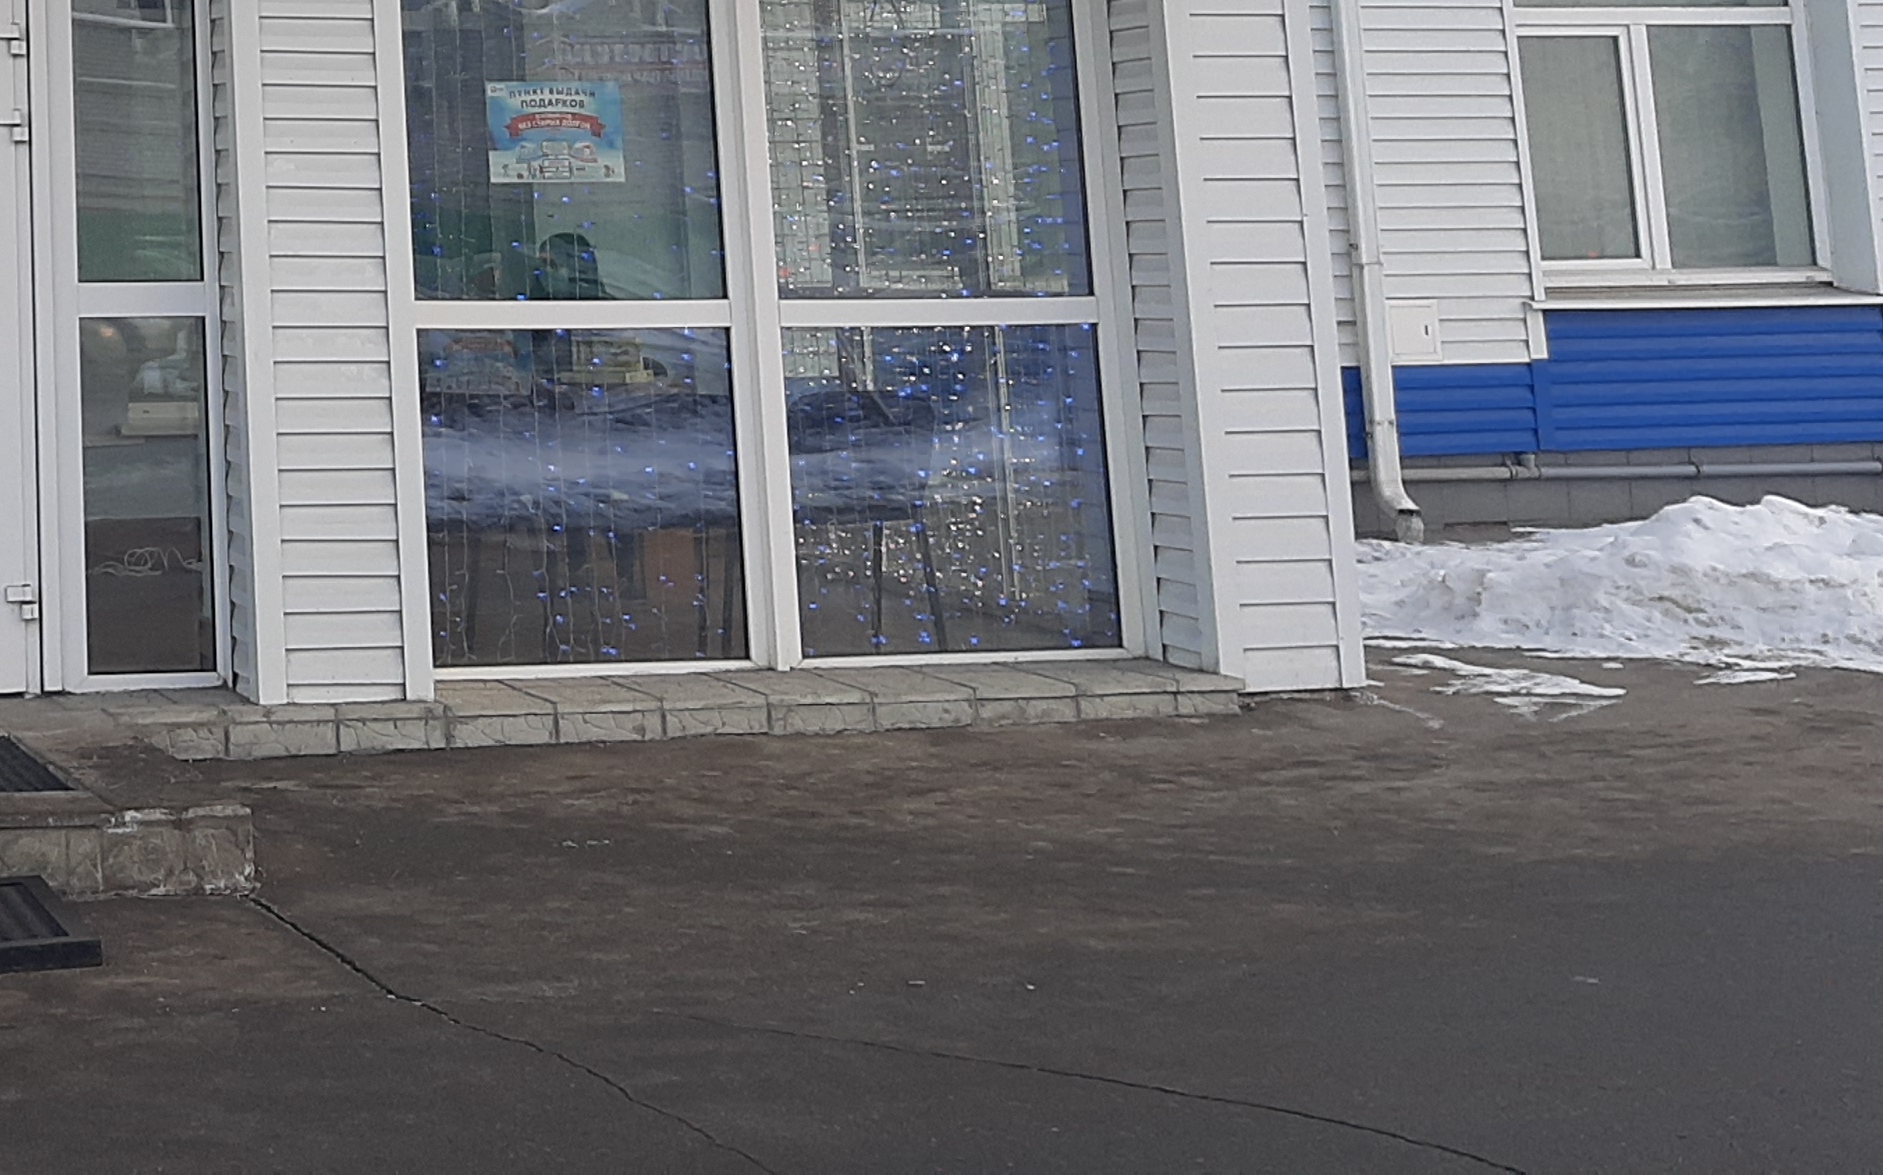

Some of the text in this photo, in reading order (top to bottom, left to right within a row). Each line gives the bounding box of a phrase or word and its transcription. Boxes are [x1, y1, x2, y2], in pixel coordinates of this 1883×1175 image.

[509, 88, 544, 99] ПУНКТ
[549, 87, 596, 98] ВЫДАЧИ
[520, 98, 586, 109] ПОДАРКОВ
